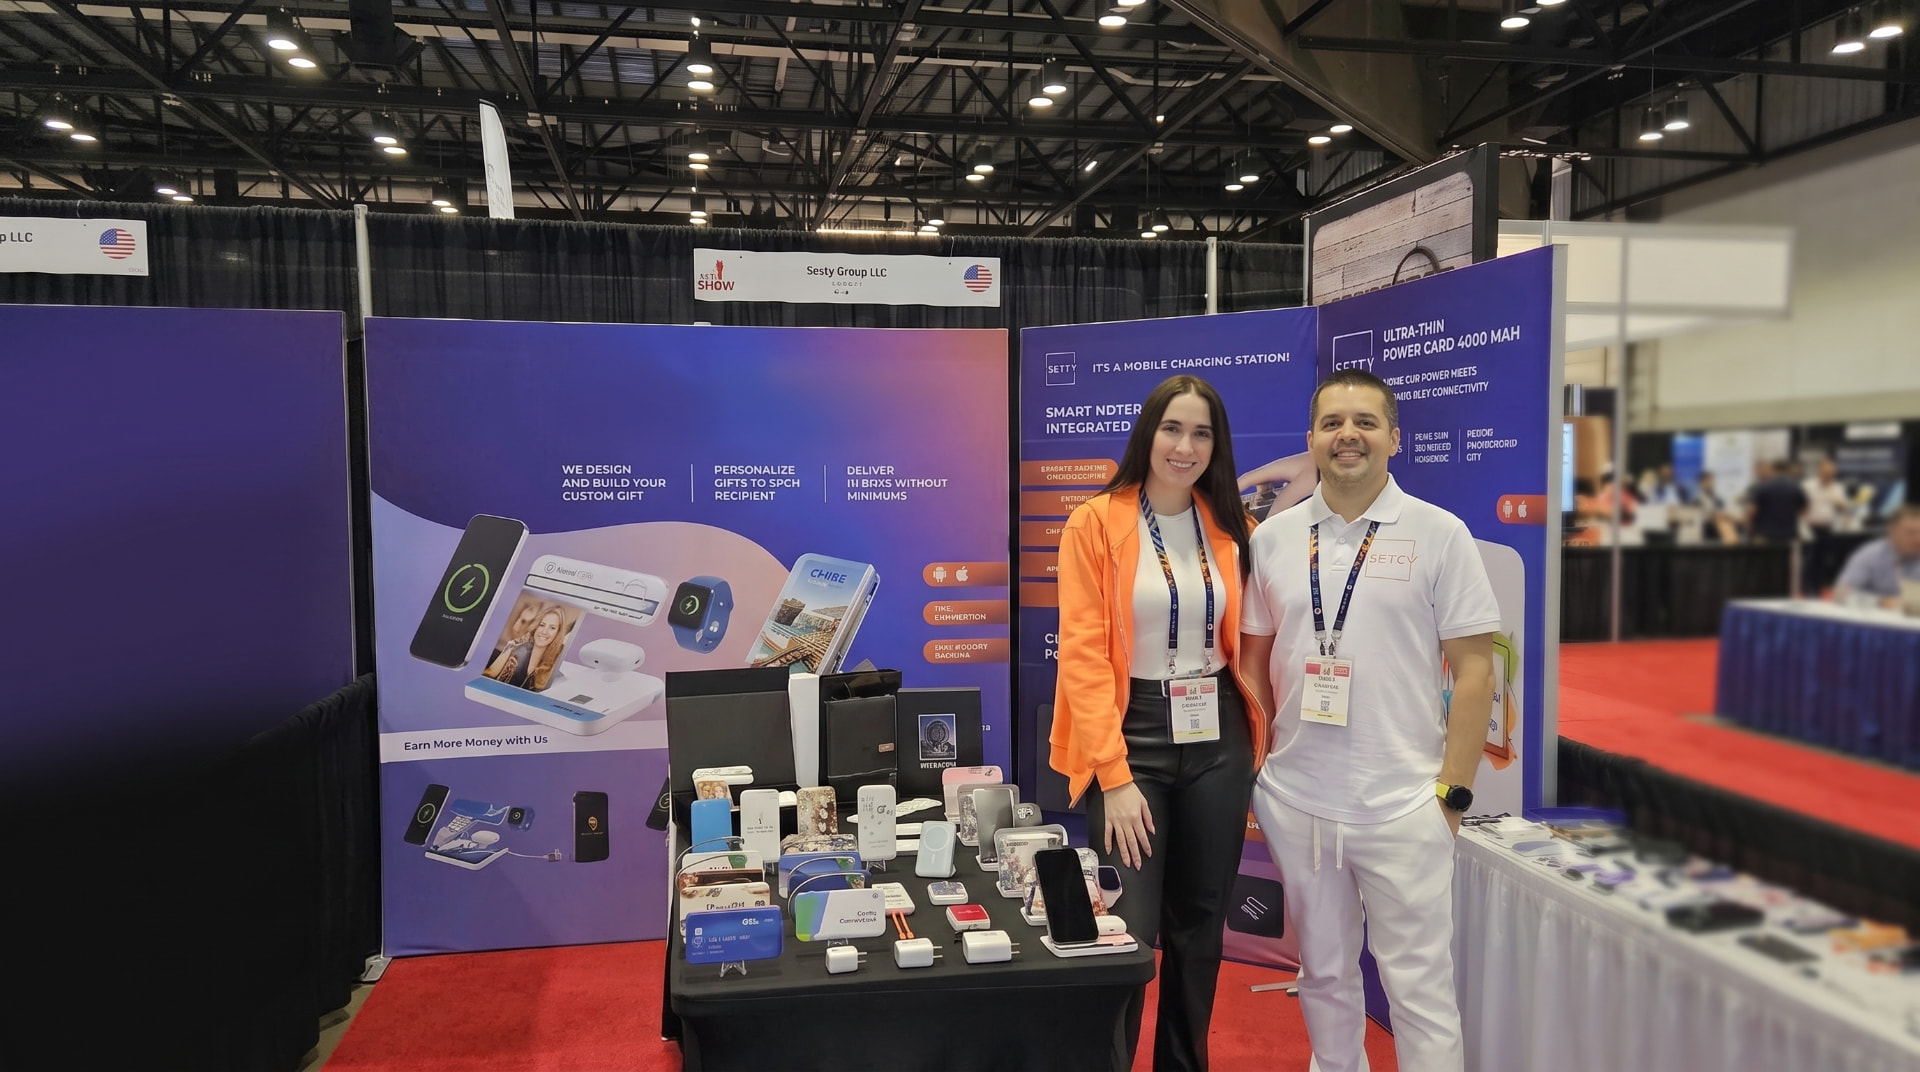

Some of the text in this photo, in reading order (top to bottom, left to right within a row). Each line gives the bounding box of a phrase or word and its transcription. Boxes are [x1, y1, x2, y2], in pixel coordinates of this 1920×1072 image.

[10, 231, 33, 243] LLC
[806, 266, 887, 279] Sesty Group LLC
[698, 280, 735, 291] SHOW
[1383, 319, 1445, 343] ULTRA-THIN
[1383, 325, 1520, 362] POWER CARD 4000 MAH
[1113, 363, 1121, 372] A
[1124, 360, 1168, 371] MOBILE
[1170, 356, 1232, 369] CHARGING
[1235, 352, 1290, 365] STATION!
[1048, 364, 1077, 374] SETTY
[1421, 369, 1449, 382] POWER
[1432, 381, 1489, 397] CONNECTIVITY
[1045, 405, 1092, 418] SMART
[1046, 421, 1131, 434] INTEGRATED
[562, 465, 632, 474] WE DESIGN
[714, 465, 796, 475] PERSONALIZE
[847, 466, 894, 475] DELIVER
[562, 478, 666, 488] AND BUILD YOUR
[714, 478, 748, 488] GIFTS
[750, 478, 766, 488] TO
[895, 479, 948, 488] WITHOUT
[562, 491, 644, 501] CUSTOM GIFT
[714, 491, 776, 501] RECIPIENT
[847, 491, 908, 501] MINIMUMS
[404, 735, 549, 751] Earn More Money with Us
